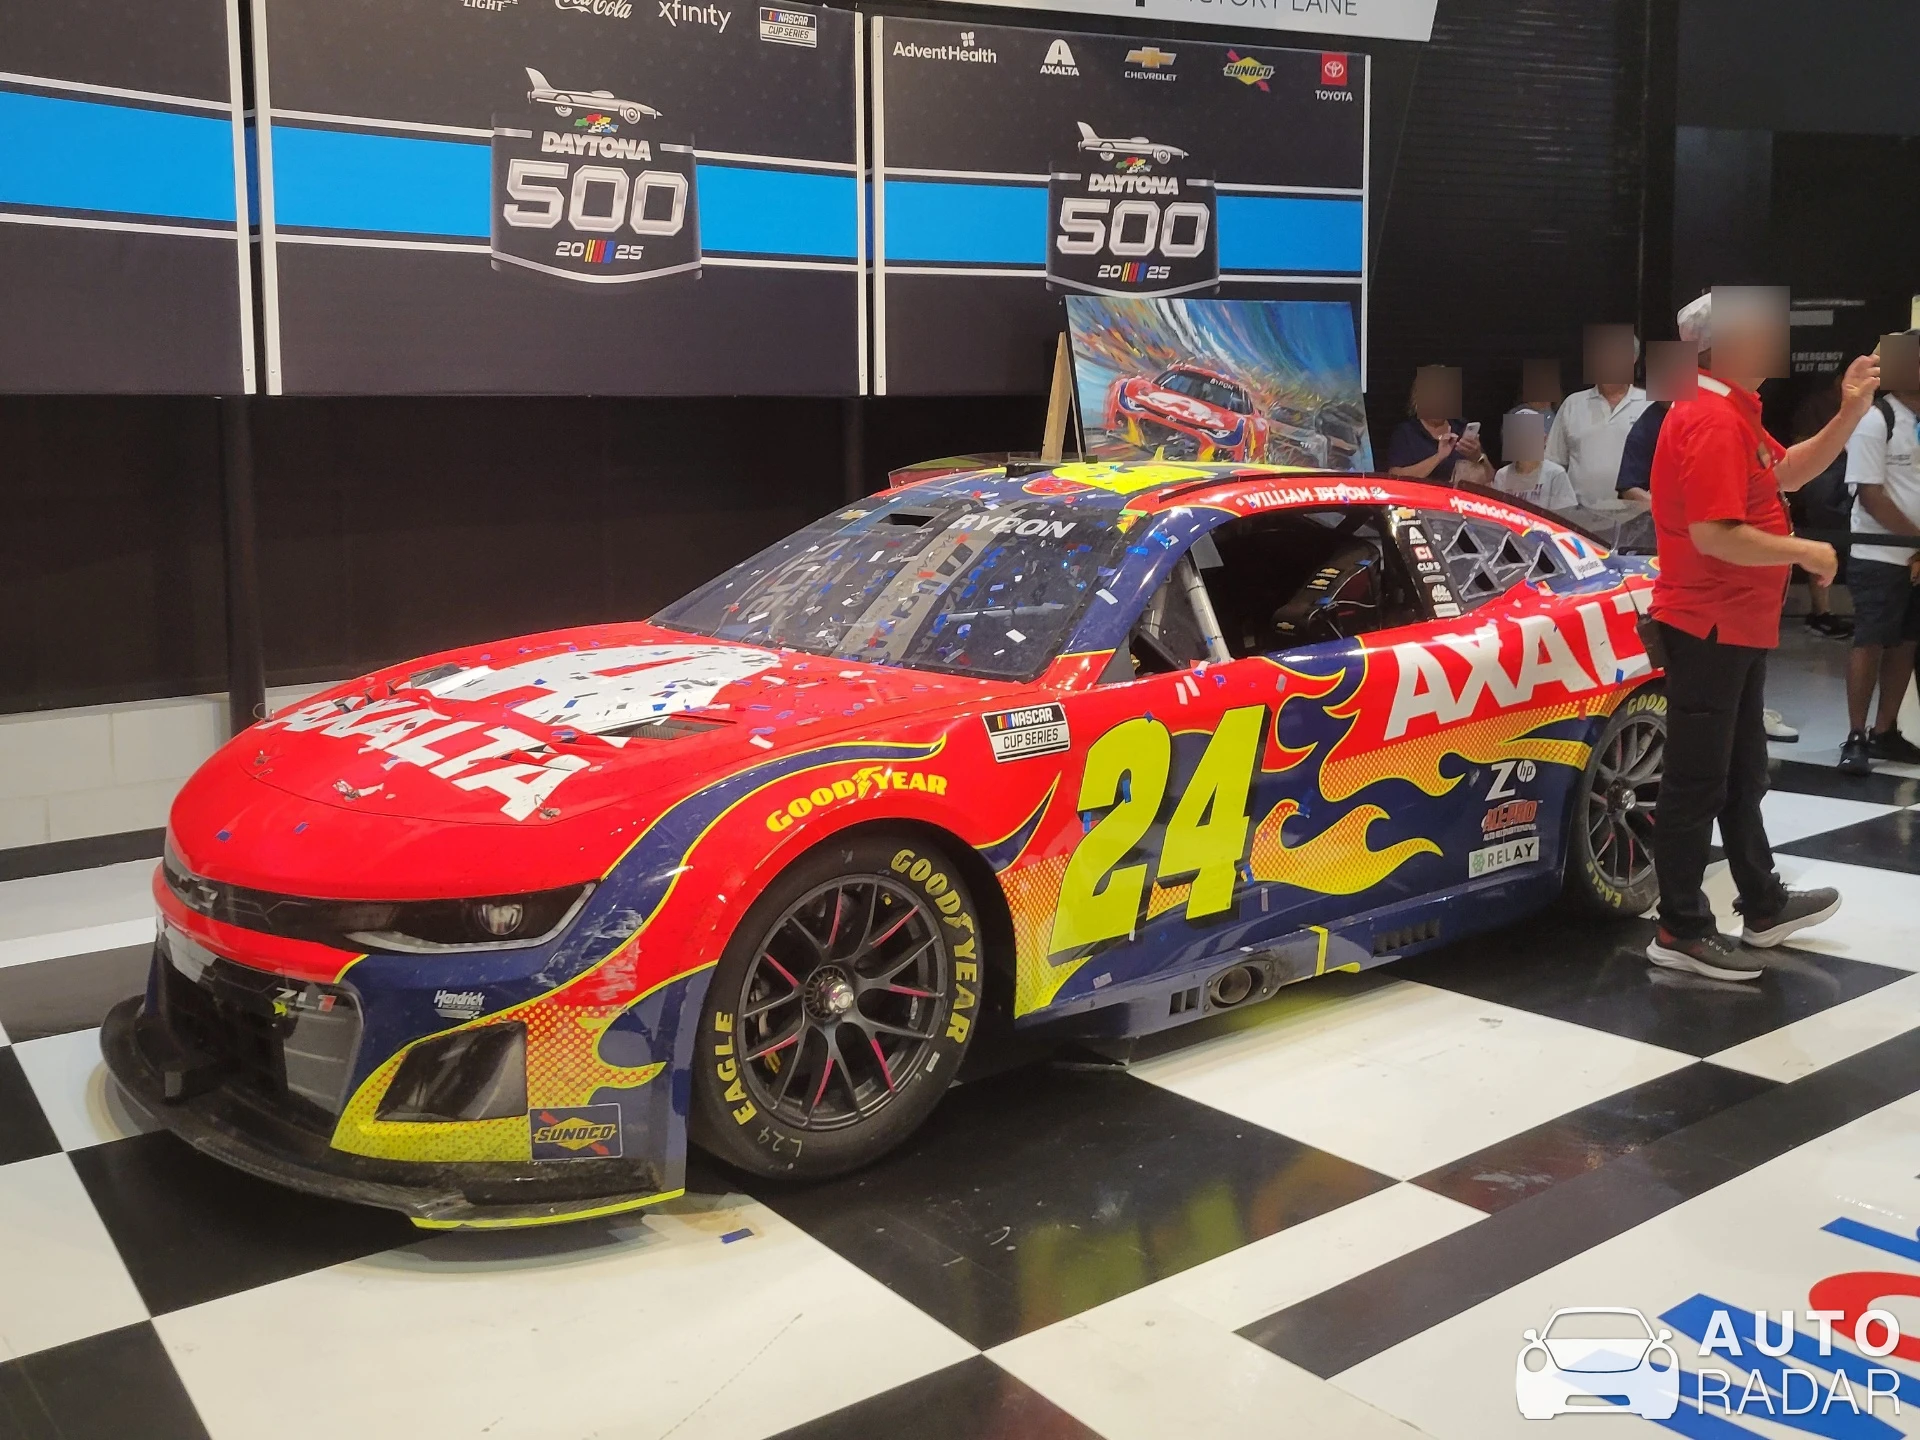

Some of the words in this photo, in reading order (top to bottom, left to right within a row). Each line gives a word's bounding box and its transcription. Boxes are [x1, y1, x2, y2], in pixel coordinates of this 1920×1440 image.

[463, 0, 504, 11] LIGHT
[658, 0, 732, 34] xfinity
[777, 12, 809, 26] NASCAR
[768, 25, 784, 36] CUP
[784, 27, 810, 39] SERIES
[893, 41, 997, 63] AdventHealth
[1040, 64, 1079, 76] AXALTA
[1124, 70, 1177, 81] CHEVROLET
[1225, 65, 1273, 78] SUNOCO
[1315, 90, 1353, 101] TOYOTA
[541, 131, 651, 161] DAYTONA
[1088, 173, 1179, 195] DAYTONA
[503, 158, 689, 236] 500
[1056, 197, 1210, 258] 500
[1242, 487, 1314, 508] WILLIAM
[1384, 588, 1654, 741] AXALT
[1010, 707, 1053, 727] NASCAR
[1003, 734, 1023, 749] CUP
[1025, 727, 1059, 746] SERIES
[256, 696, 590, 821] AXALTA
[1484, 761, 1517, 801] Z
[1519, 760, 1535, 783] hp
[766, 766, 948, 832] GOODYEAR
[1048, 705, 1269, 957] 24
[1487, 843, 1535, 868] RELAY
[889, 849, 977, 1043] GOODYEAR
[433, 990, 485, 1007] Hendrick
[714, 1011, 758, 1126] EAGLE
[537, 1126, 613, 1141] SUNOCO
